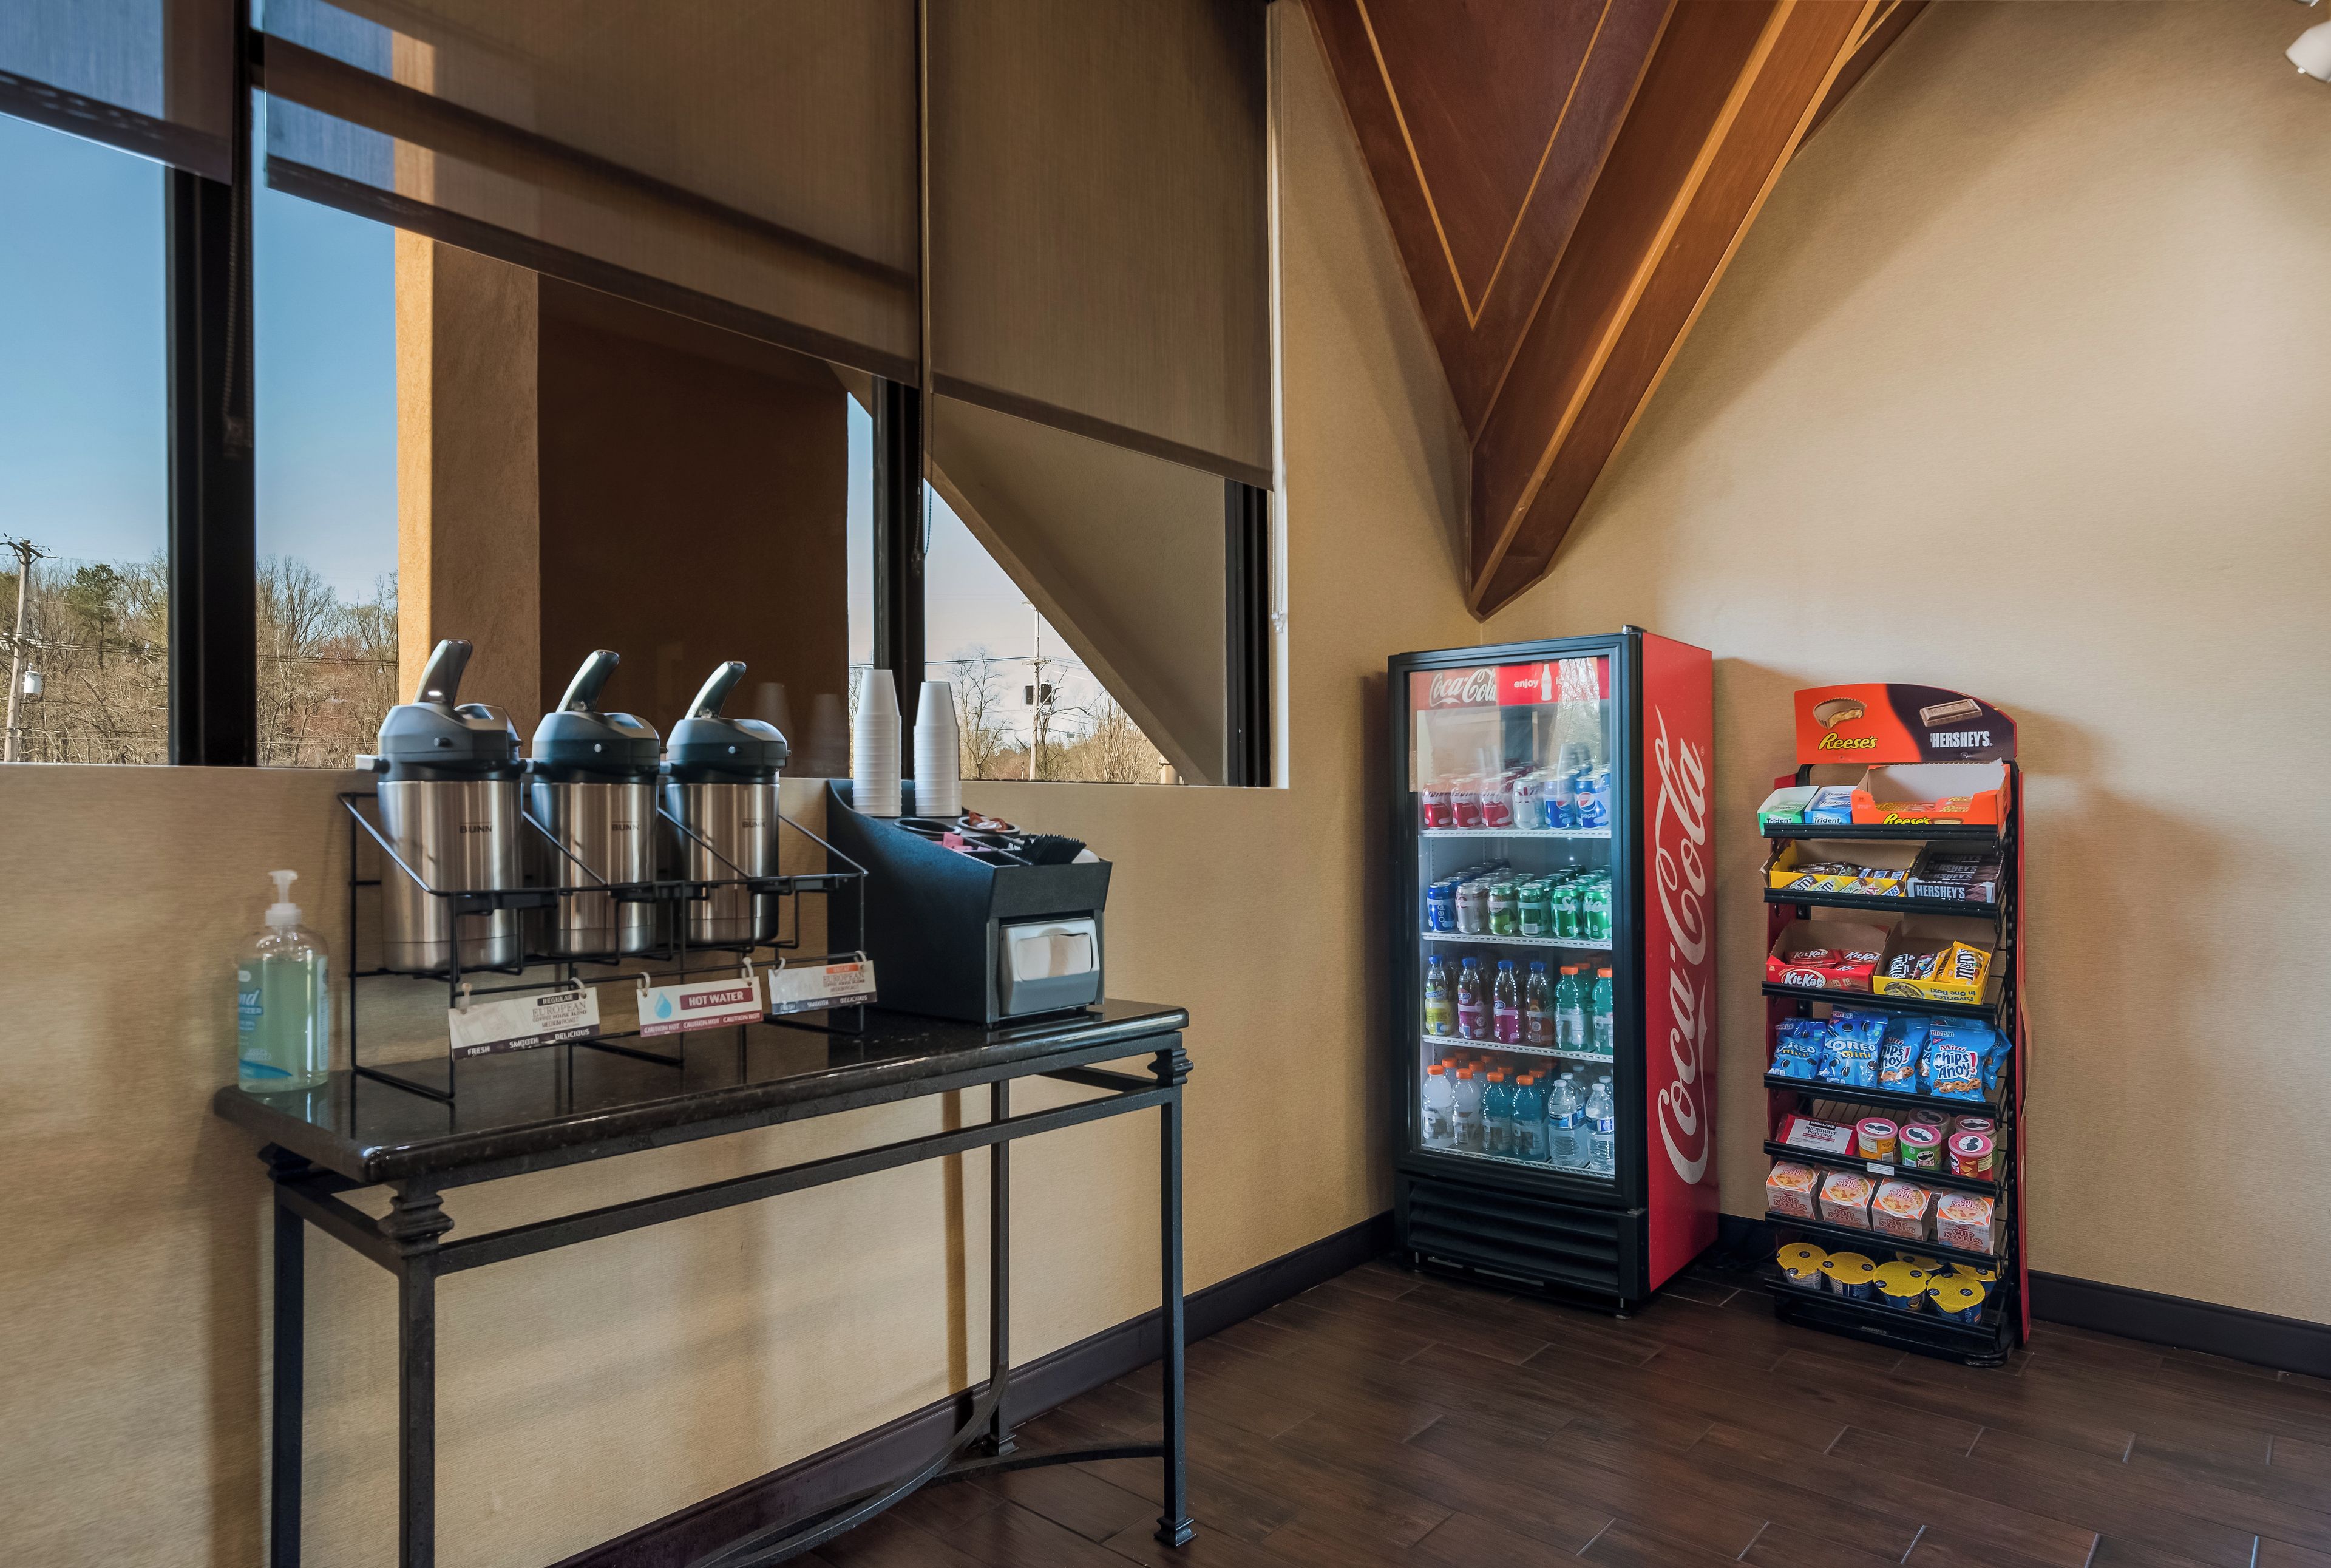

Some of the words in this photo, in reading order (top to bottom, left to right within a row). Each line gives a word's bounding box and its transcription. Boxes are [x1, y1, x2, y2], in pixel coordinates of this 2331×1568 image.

[1514, 679, 1539, 688] enjoy
[1818, 732, 1878, 750] Reese's
[1932, 731, 1990, 748] HERSHEY'S
[1916, 884, 1966, 898] HERSHEY'S
[1655, 704, 1708, 1184] Coca-Cola
[1784, 972, 1824, 987] KitKat
[543, 994, 574, 1005] REGULAR
[688, 994, 707, 1006] HOT
[709, 991, 744, 1002] WATER
[532, 1000, 586, 1017] EUROPEAN
[553, 1012, 570, 1020] HOUSE
[683, 1020, 707, 1028] CAUTION
[467, 1045, 491, 1056] FRESH
[509, 1037, 540, 1049] SMOOTH
[555, 1028, 590, 1040] DELICIOUS
[1833, 1040, 1876, 1052] OREO
[1841, 1050, 1872, 1059] mini
[1934, 1051, 1969, 1068] Chips
[1805, 1125, 1838, 1135] MICROWAVE
[1808, 1130, 1833, 1138] POPCORN
[1952, 1229, 1975, 1237] CUP
